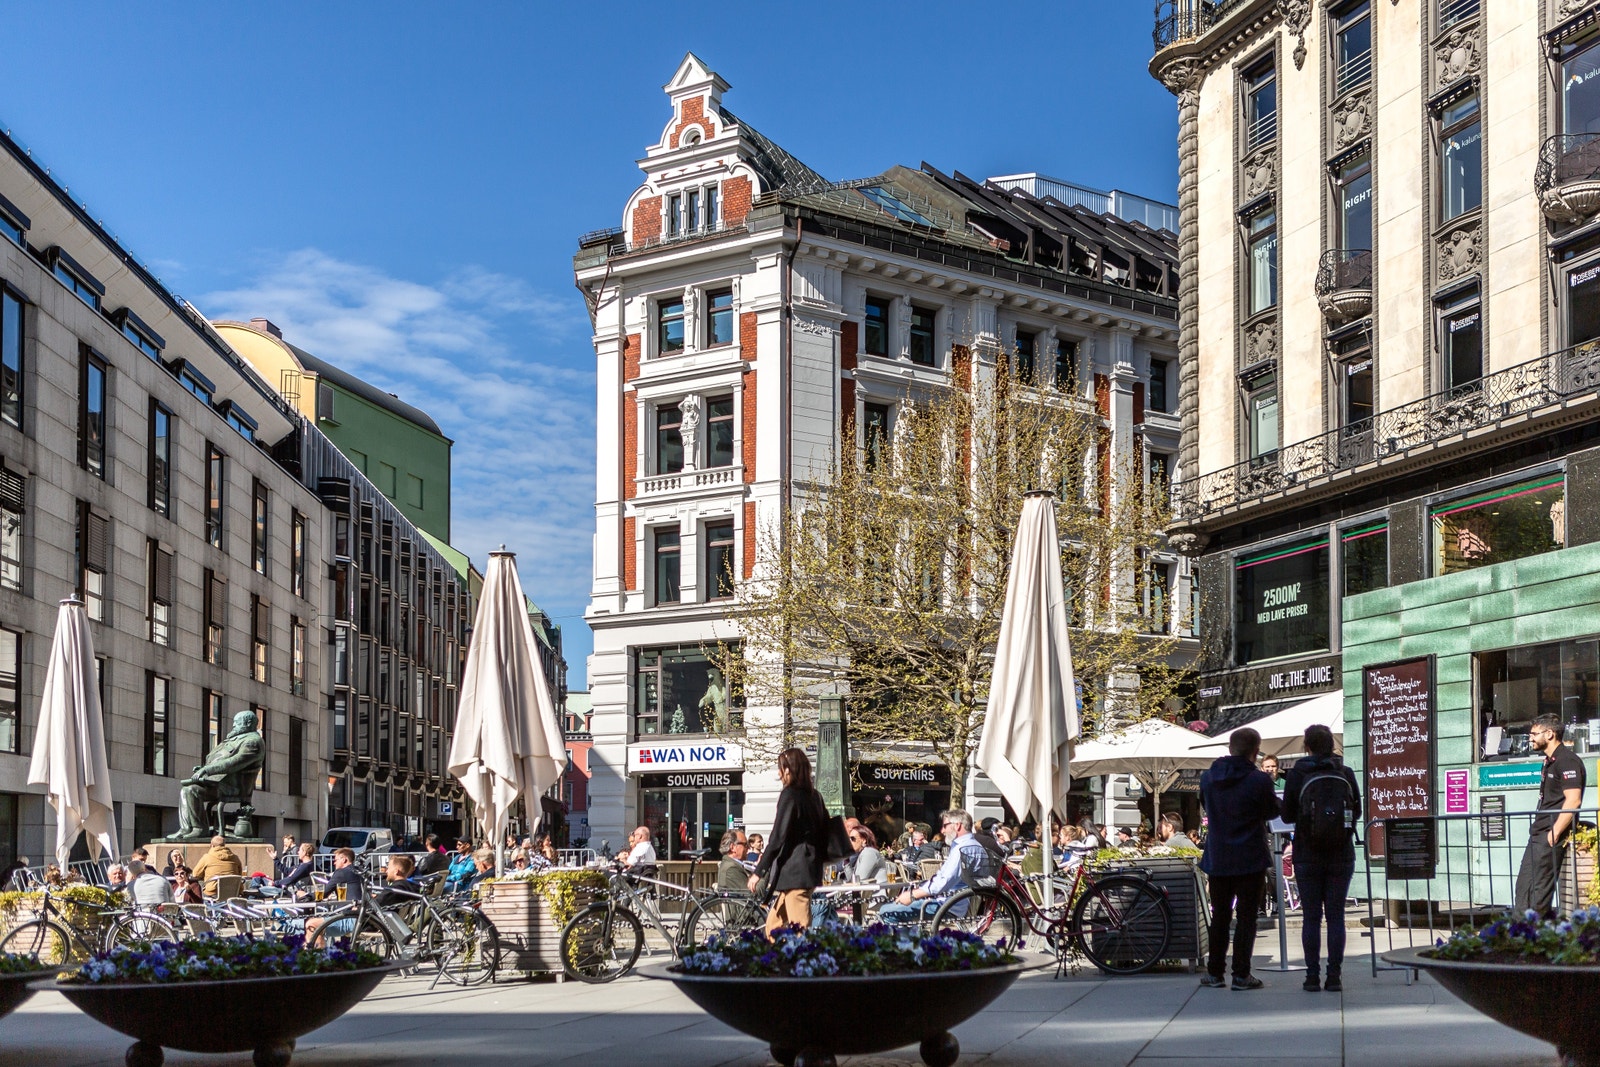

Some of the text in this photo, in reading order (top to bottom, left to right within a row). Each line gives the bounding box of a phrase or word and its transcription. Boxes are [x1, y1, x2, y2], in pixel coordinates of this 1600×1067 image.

[1345, 188, 1372, 209] RIGHT
[1254, 239, 1277, 257] RIGHT
[1257, 603, 1308, 624] MED LAVE PRISER
[1269, 673, 1284, 689] JOE
[1289, 670, 1305, 687] THE
[1307, 665, 1331, 684] JUICE
[690, 746, 726, 762] NOR
[667, 773, 731, 787] SOUVENIRS
[874, 767, 935, 781] SOUVENIRS
[1415, 783, 1426, 795] ta
